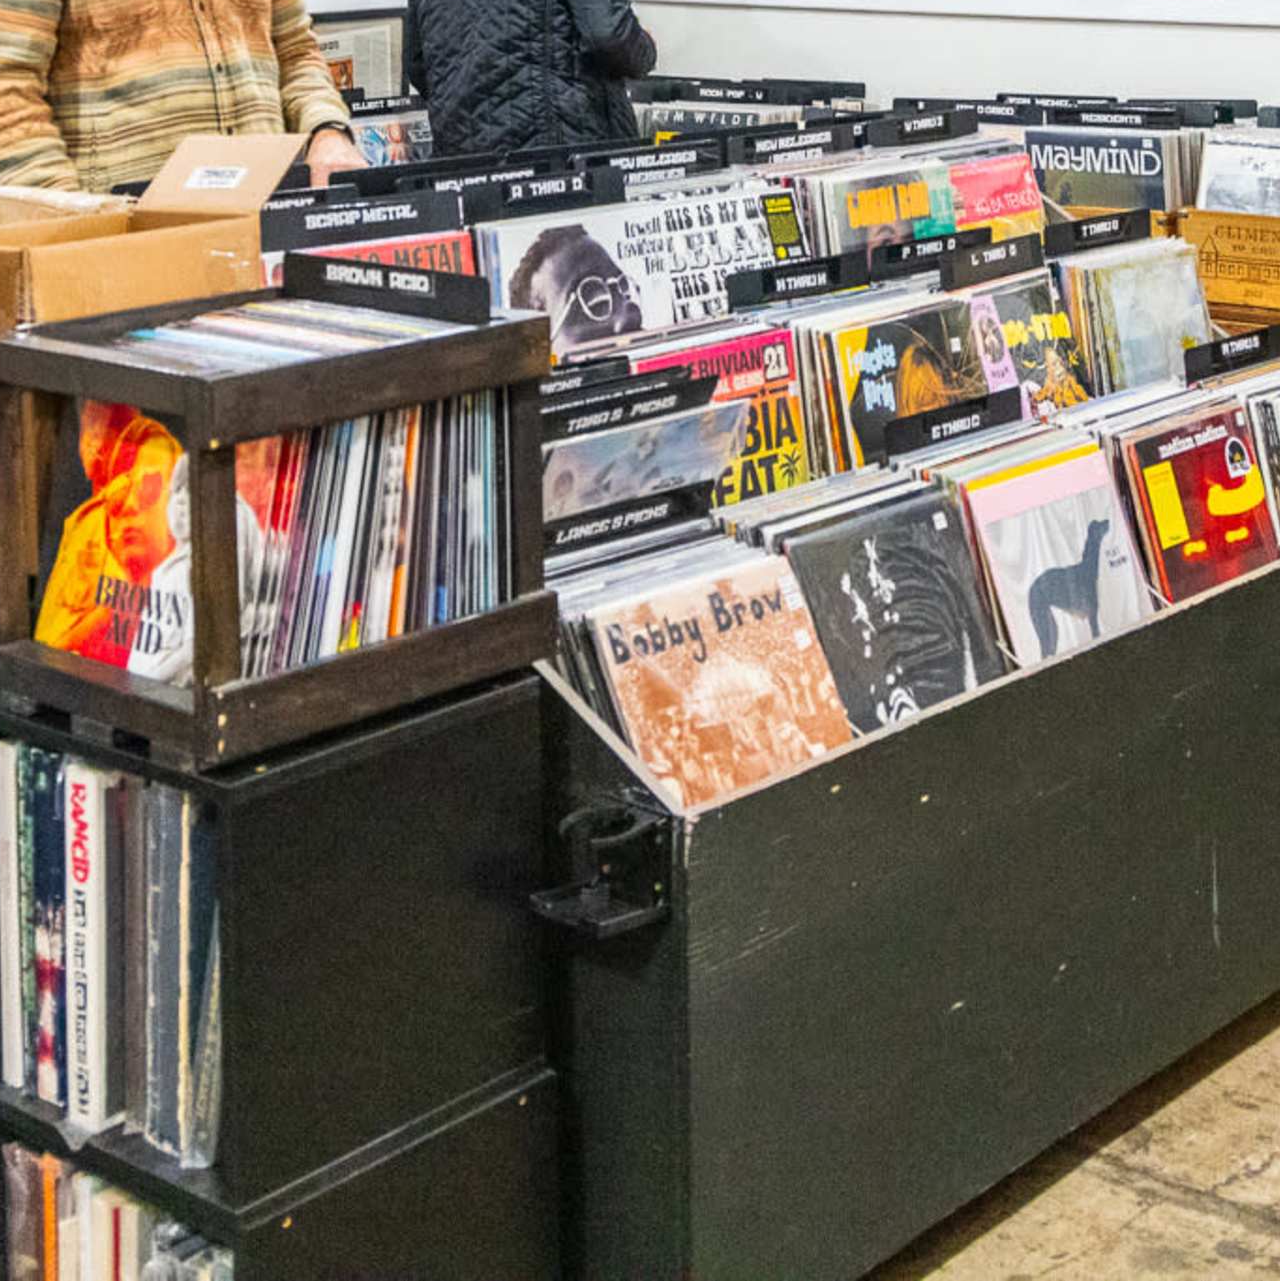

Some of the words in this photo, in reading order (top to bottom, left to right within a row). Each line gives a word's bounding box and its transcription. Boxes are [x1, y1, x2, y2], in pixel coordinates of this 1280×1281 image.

[651, 109, 684, 122] KIM
[694, 111, 754, 126] WILDE
[530, 179, 566, 196] THRU
[305, 209, 361, 230] SCRAP
[362, 203, 418, 224] METAL
[325, 264, 383, 287] BROWN
[389, 271, 430, 293] ACID
[787, 274, 815, 291] THRU
[763, 343, 787, 380] 21
[742, 396, 799, 457] BIA
[941, 418, 970, 438] THRU
[716, 454, 779, 506] EAT
[96, 575, 187, 628] BROWN
[105, 613, 163, 655] ACID
[606, 614, 708, 665] Bobby
[707, 587, 784, 633] Brow
[69, 782, 91, 884] RANCID
